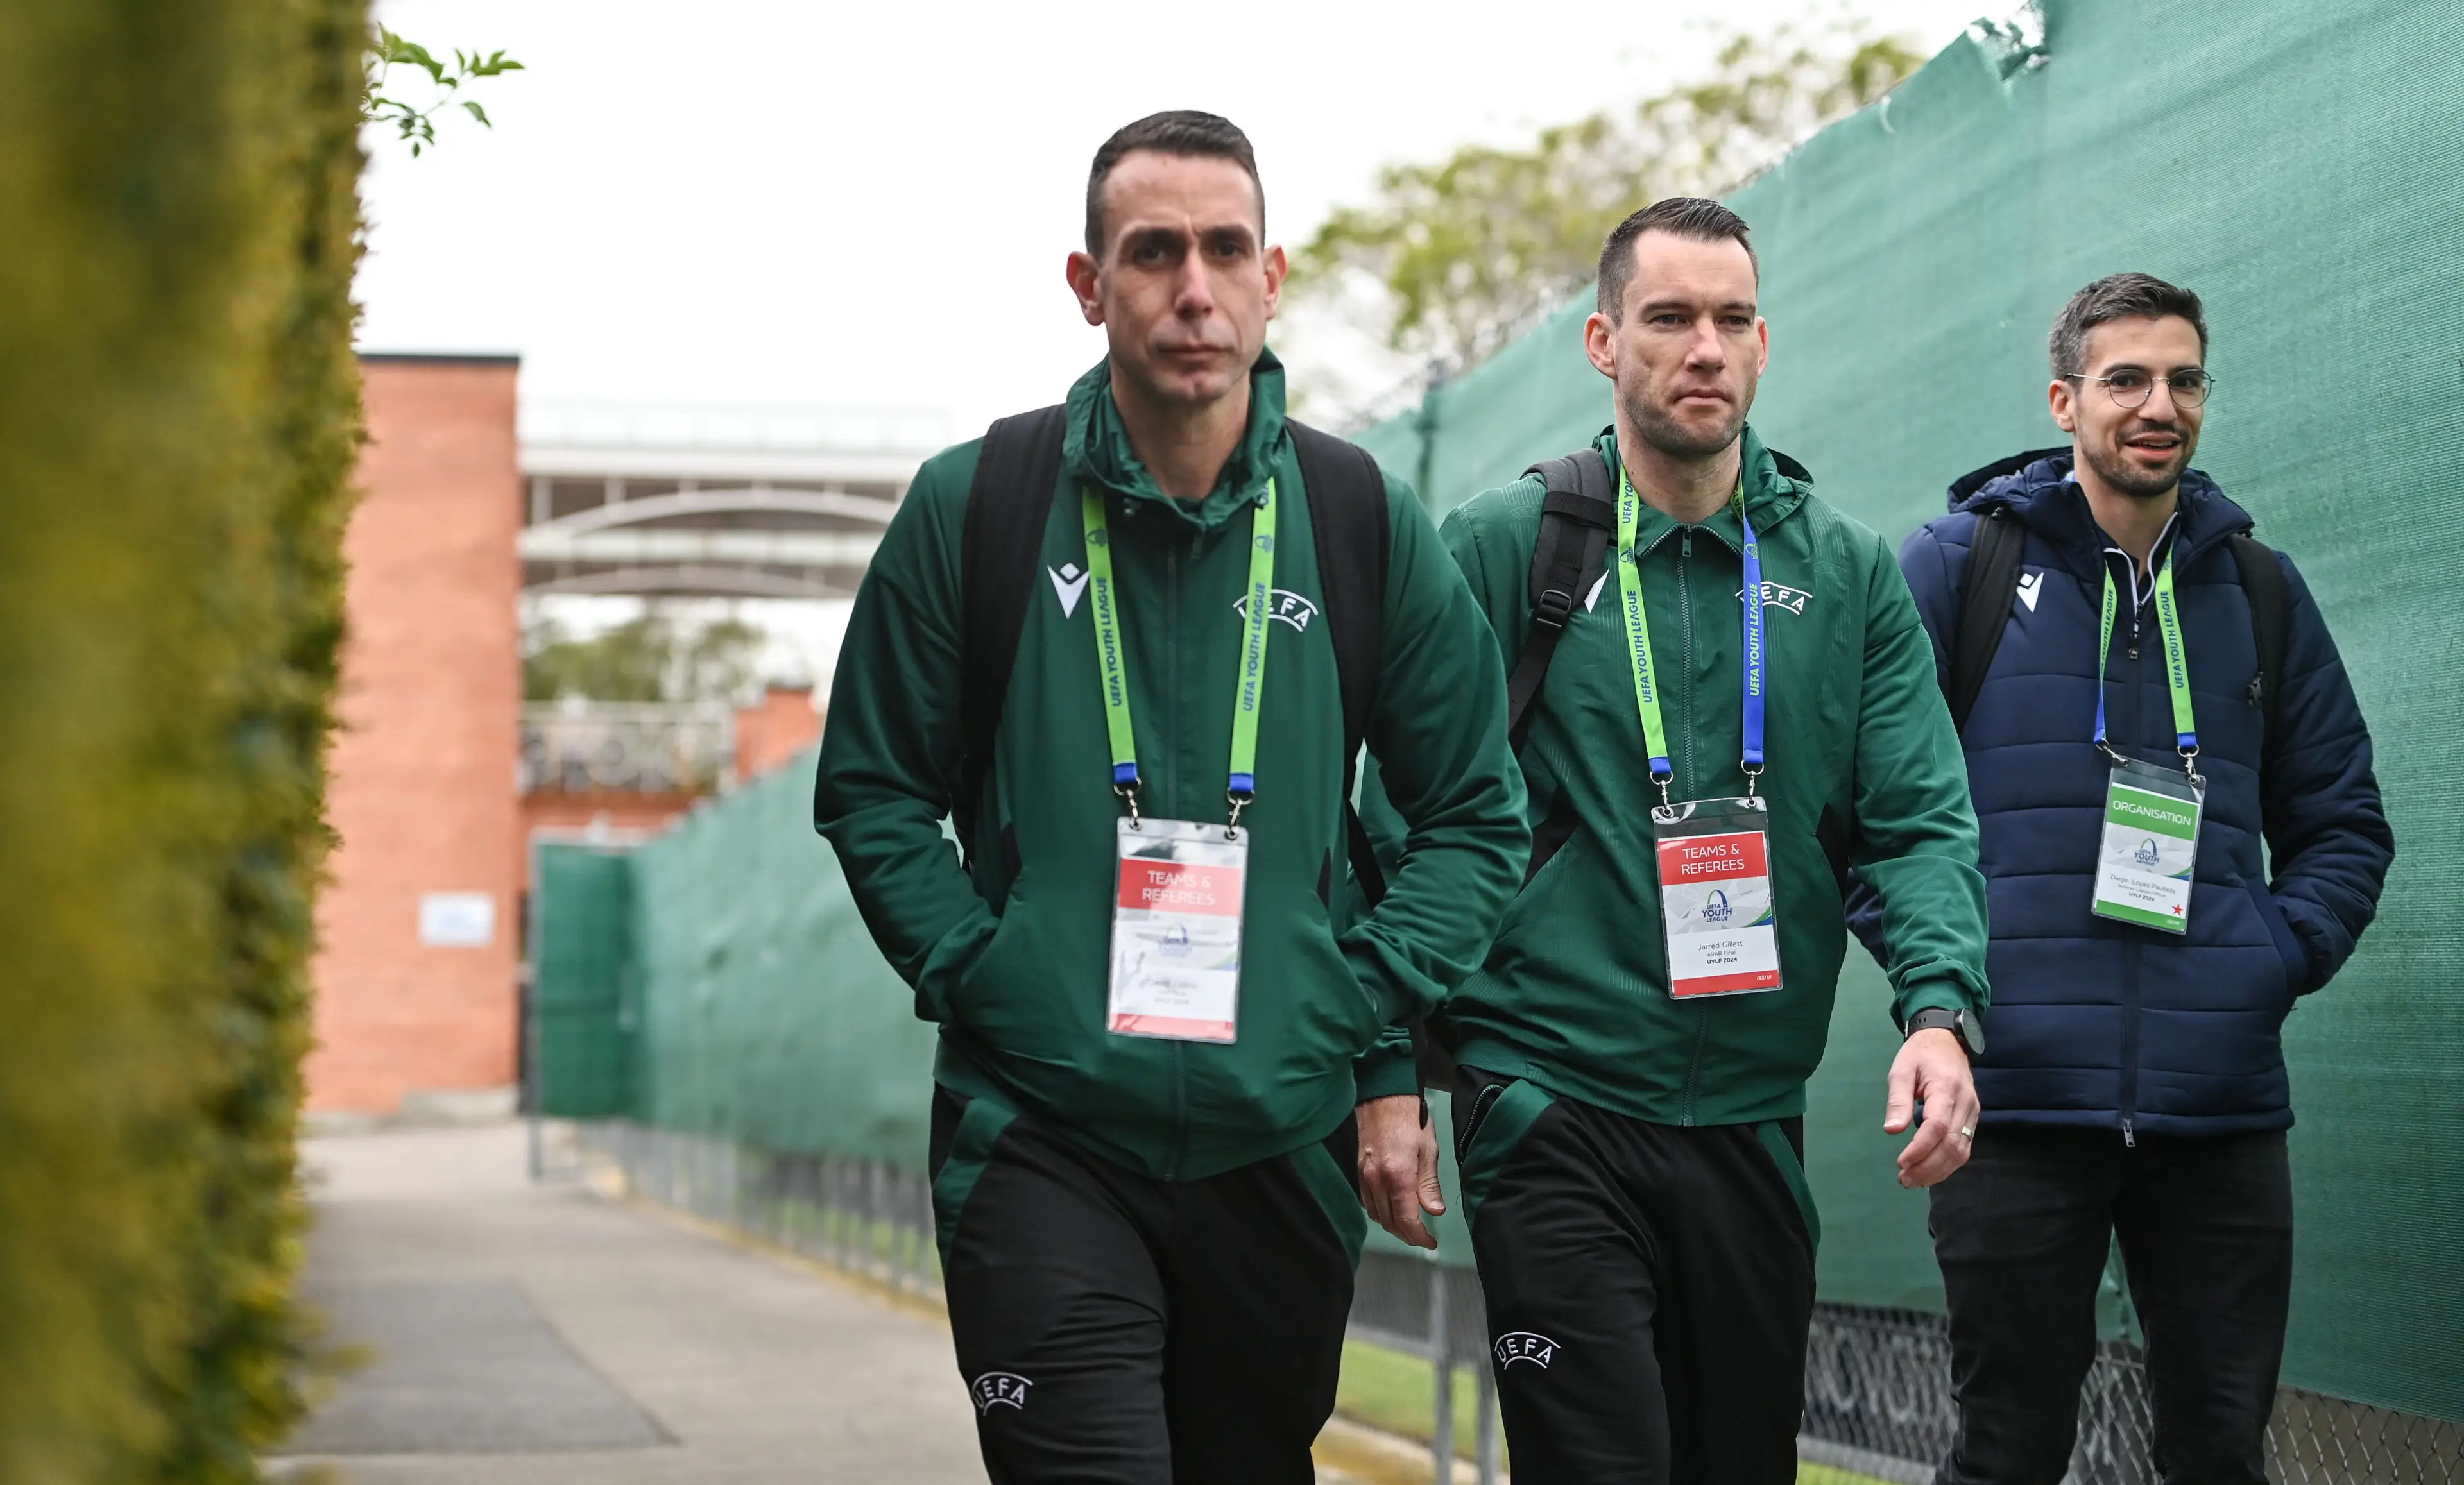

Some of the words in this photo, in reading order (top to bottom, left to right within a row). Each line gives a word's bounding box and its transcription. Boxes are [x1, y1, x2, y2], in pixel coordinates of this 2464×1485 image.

[1622, 500, 1633, 524] UEFA
[1096, 577, 1111, 626] LEAGUE
[1253, 582, 1265, 631] LEAGUE
[1627, 590, 1642, 632] LEAGUE
[1740, 586, 1805, 611] EFA
[1749, 582, 1759, 625] LEAGUE
[2105, 589, 2114, 626] LEAGUE
[2160, 591, 2174, 627] LEAGUE
[1102, 629, 1118, 673] YOUTH
[1247, 634, 1260, 677] YOUTH
[1634, 635, 1648, 674] YOUTH
[1749, 628, 1759, 666] YOUTH
[2167, 630, 2180, 663] YOUTH
[1109, 675, 1122, 707] UEFA
[1640, 675, 1653, 704] UEFA
[1750, 668, 1760, 697] UEFA
[2173, 664, 2184, 688] UEFA
[1243, 681, 1256, 711] UEFA
[2113, 800, 2191, 826] ORGANISATION
[1681, 858, 1745, 875] REFEREES
[1682, 845, 1727, 860] TEAMS
[1731, 843, 1740, 855] &
[2135, 852, 2160, 863] YOUTH
[1147, 870, 1196, 888] TEAMS
[1202, 876, 1211, 889] &
[1142, 887, 1215, 906] REFEREES
[1702, 908, 1733, 918] YOUTH
[1497, 1338, 1552, 1364] UEFA
[973, 1377, 1025, 1409] UEFA
